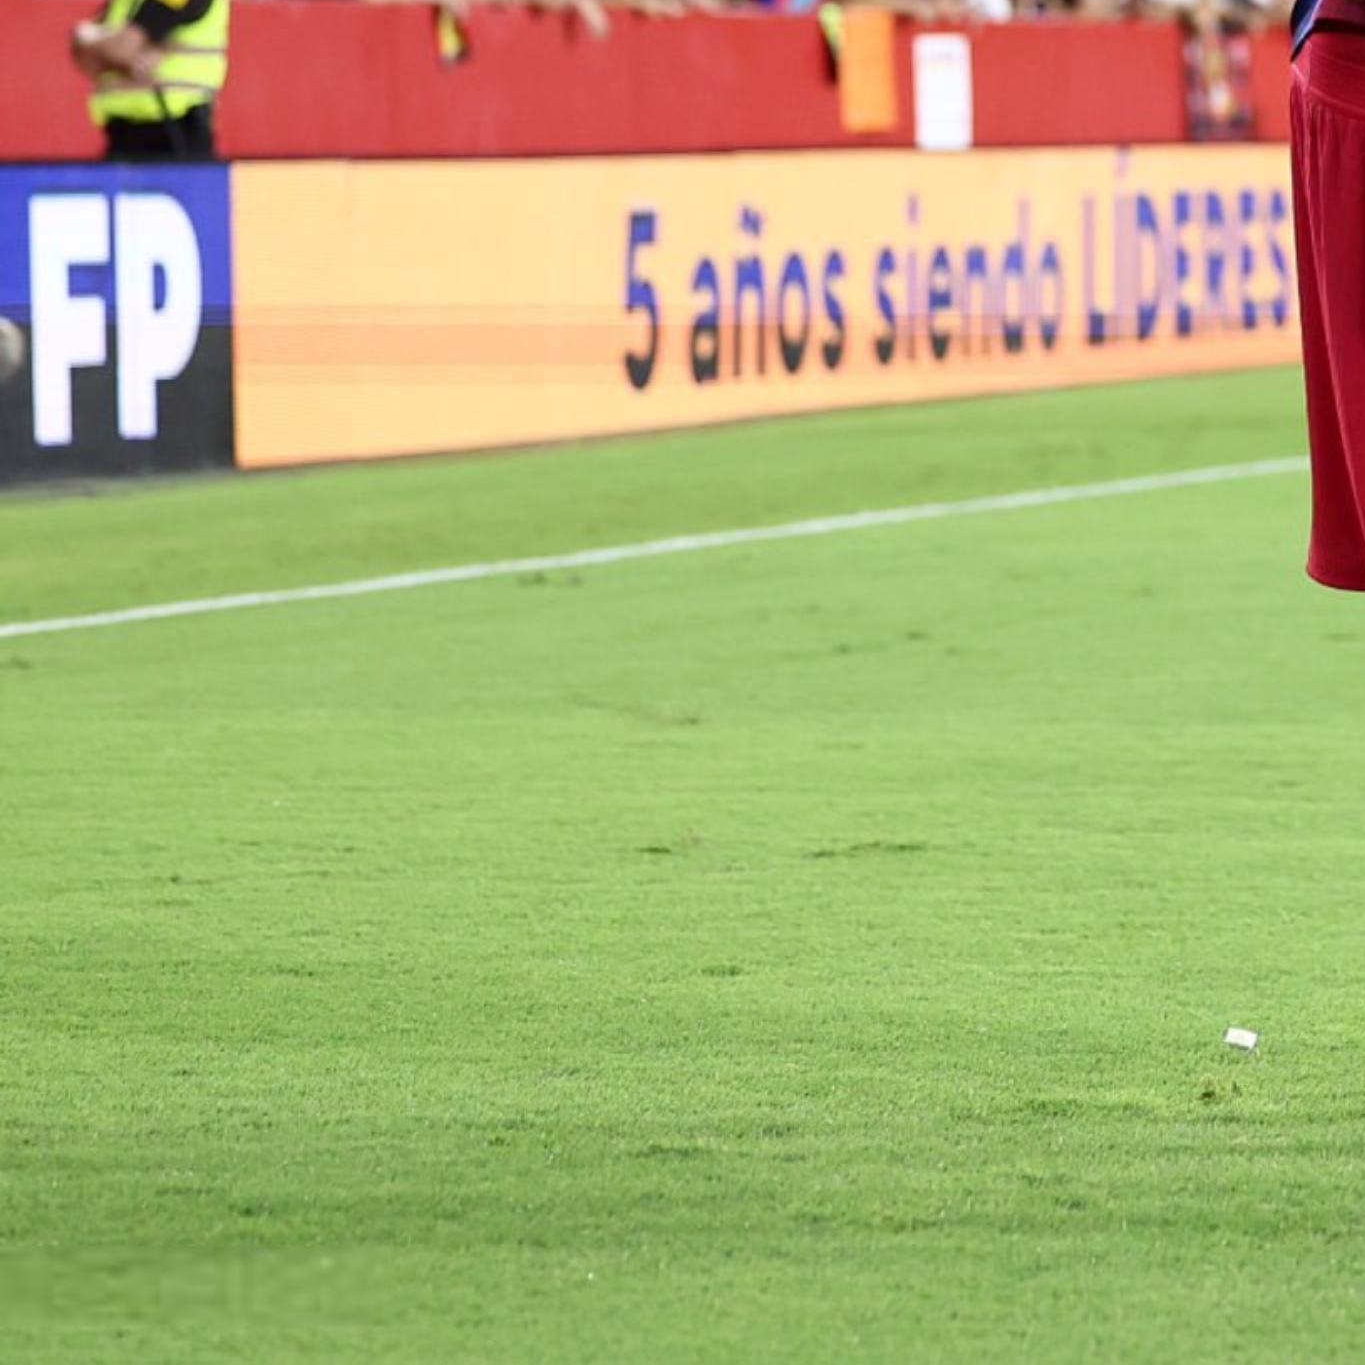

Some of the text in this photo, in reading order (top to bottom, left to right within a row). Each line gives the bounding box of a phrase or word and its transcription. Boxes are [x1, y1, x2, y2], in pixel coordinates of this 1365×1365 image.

[28, 192, 202, 447] FP
[624, 209, 659, 392] 5
[690, 206, 847, 385] años
[876, 195, 1064, 363] siendo
